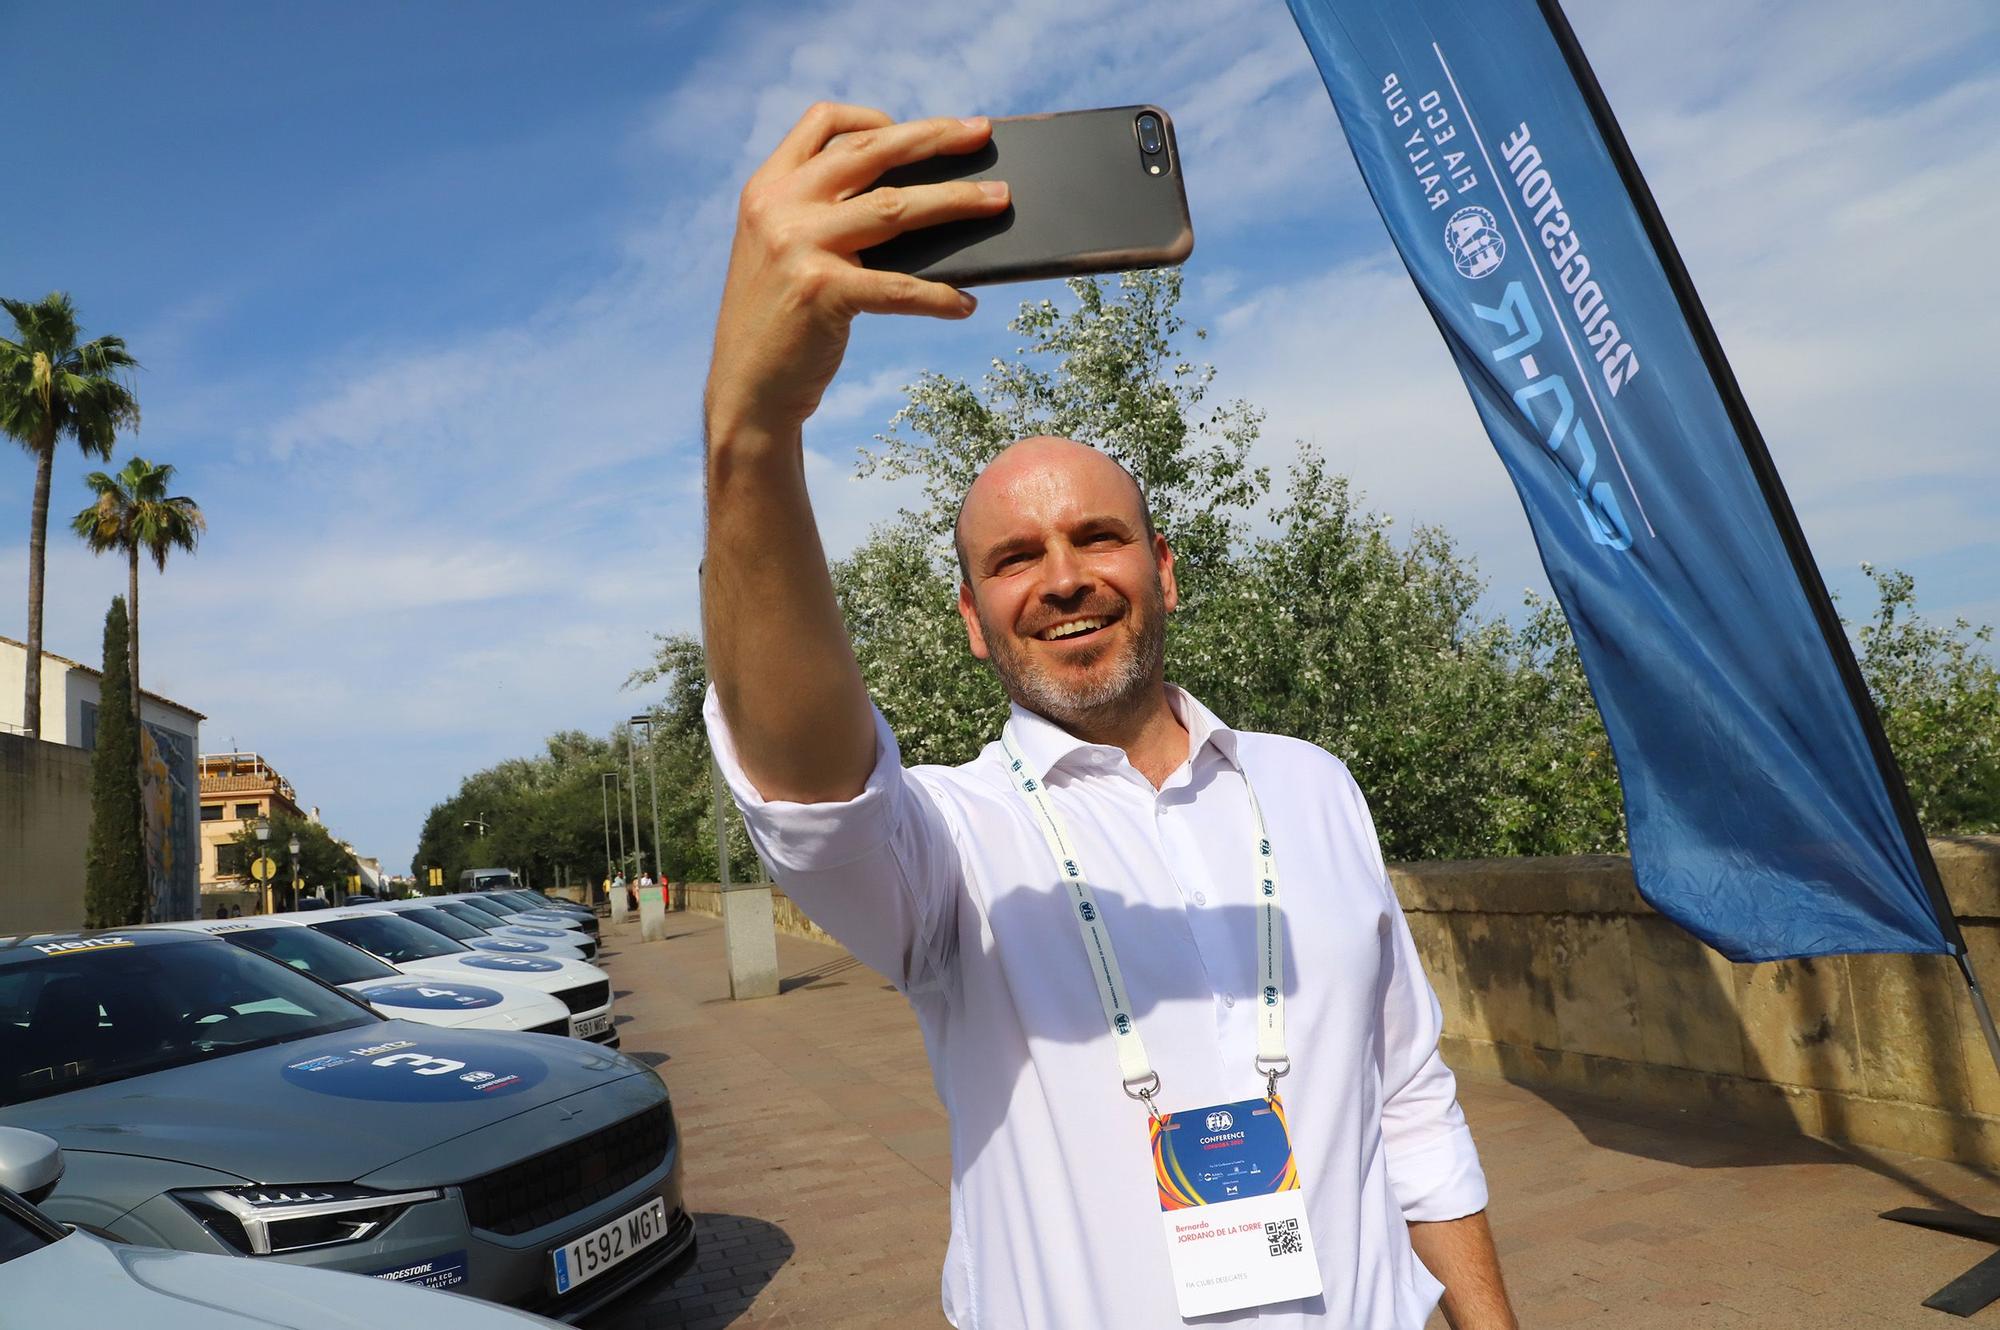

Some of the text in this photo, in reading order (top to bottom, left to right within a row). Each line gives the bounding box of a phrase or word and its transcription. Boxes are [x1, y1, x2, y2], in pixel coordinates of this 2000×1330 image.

[33, 938, 130, 954] Hertz
[416, 988, 458, 998] 4
[1115, 1014, 1130, 1035] FIA
[350, 1041, 416, 1055] Hertz
[371, 1053, 466, 1075] 3
[1207, 1113, 1232, 1130] FIA
[1200, 1131, 1245, 1144] CONFERENCE
[1175, 1221, 1209, 1233] Bernardo
[1178, 1222, 1262, 1243] JORDANO DE LA TORRE
[574, 1204, 660, 1276] 1592 MGT
[426, 1276, 437, 1284] FIA
[439, 1272, 452, 1281] ECO
[449, 1276, 461, 1284] CUP
